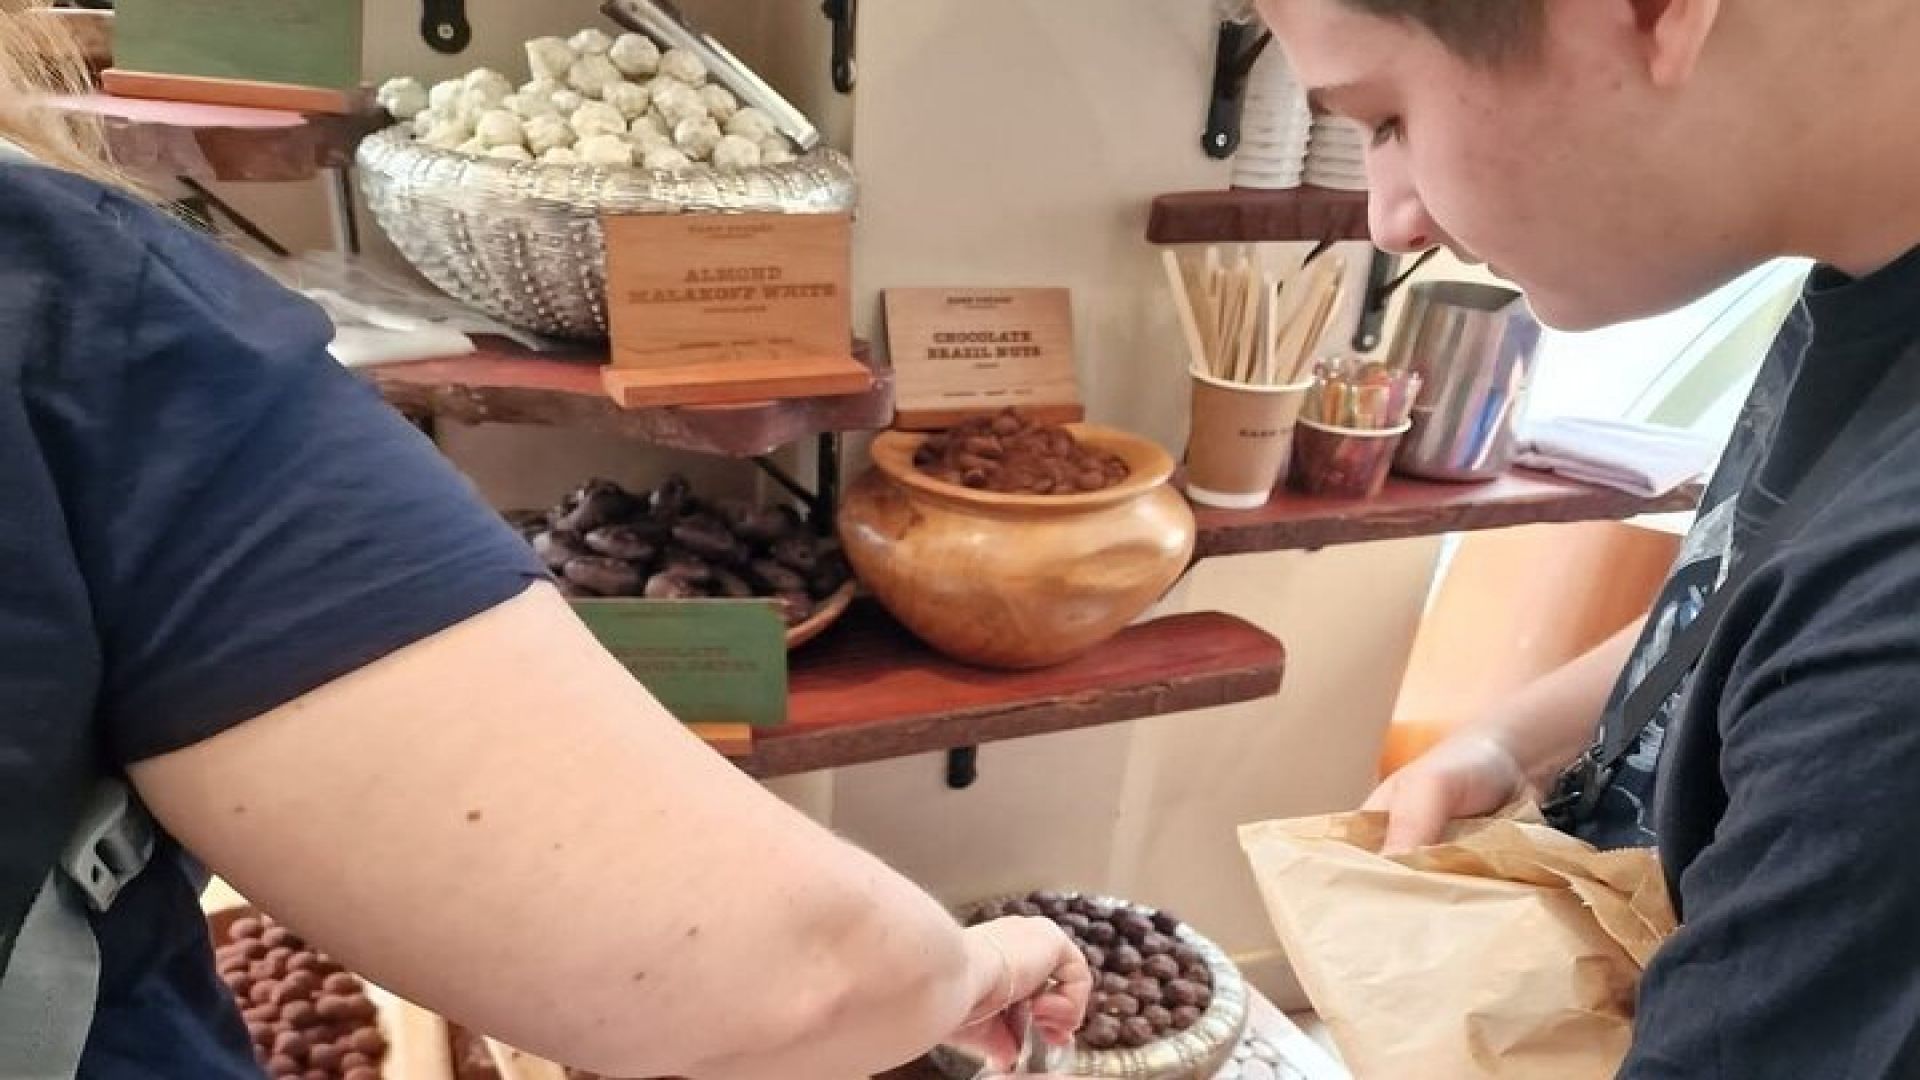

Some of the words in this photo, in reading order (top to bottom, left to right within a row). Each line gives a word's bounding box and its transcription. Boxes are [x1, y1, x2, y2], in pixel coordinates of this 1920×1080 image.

[684, 267, 782, 283] ALMOND
[628, 286, 757, 304] MALAKOFF
[763, 283, 836, 298] WHITE
[933, 331, 1033, 343] CHOCOLATE
[927, 347, 993, 361] BRAZIL
[996, 346, 1041, 359] NUTS
